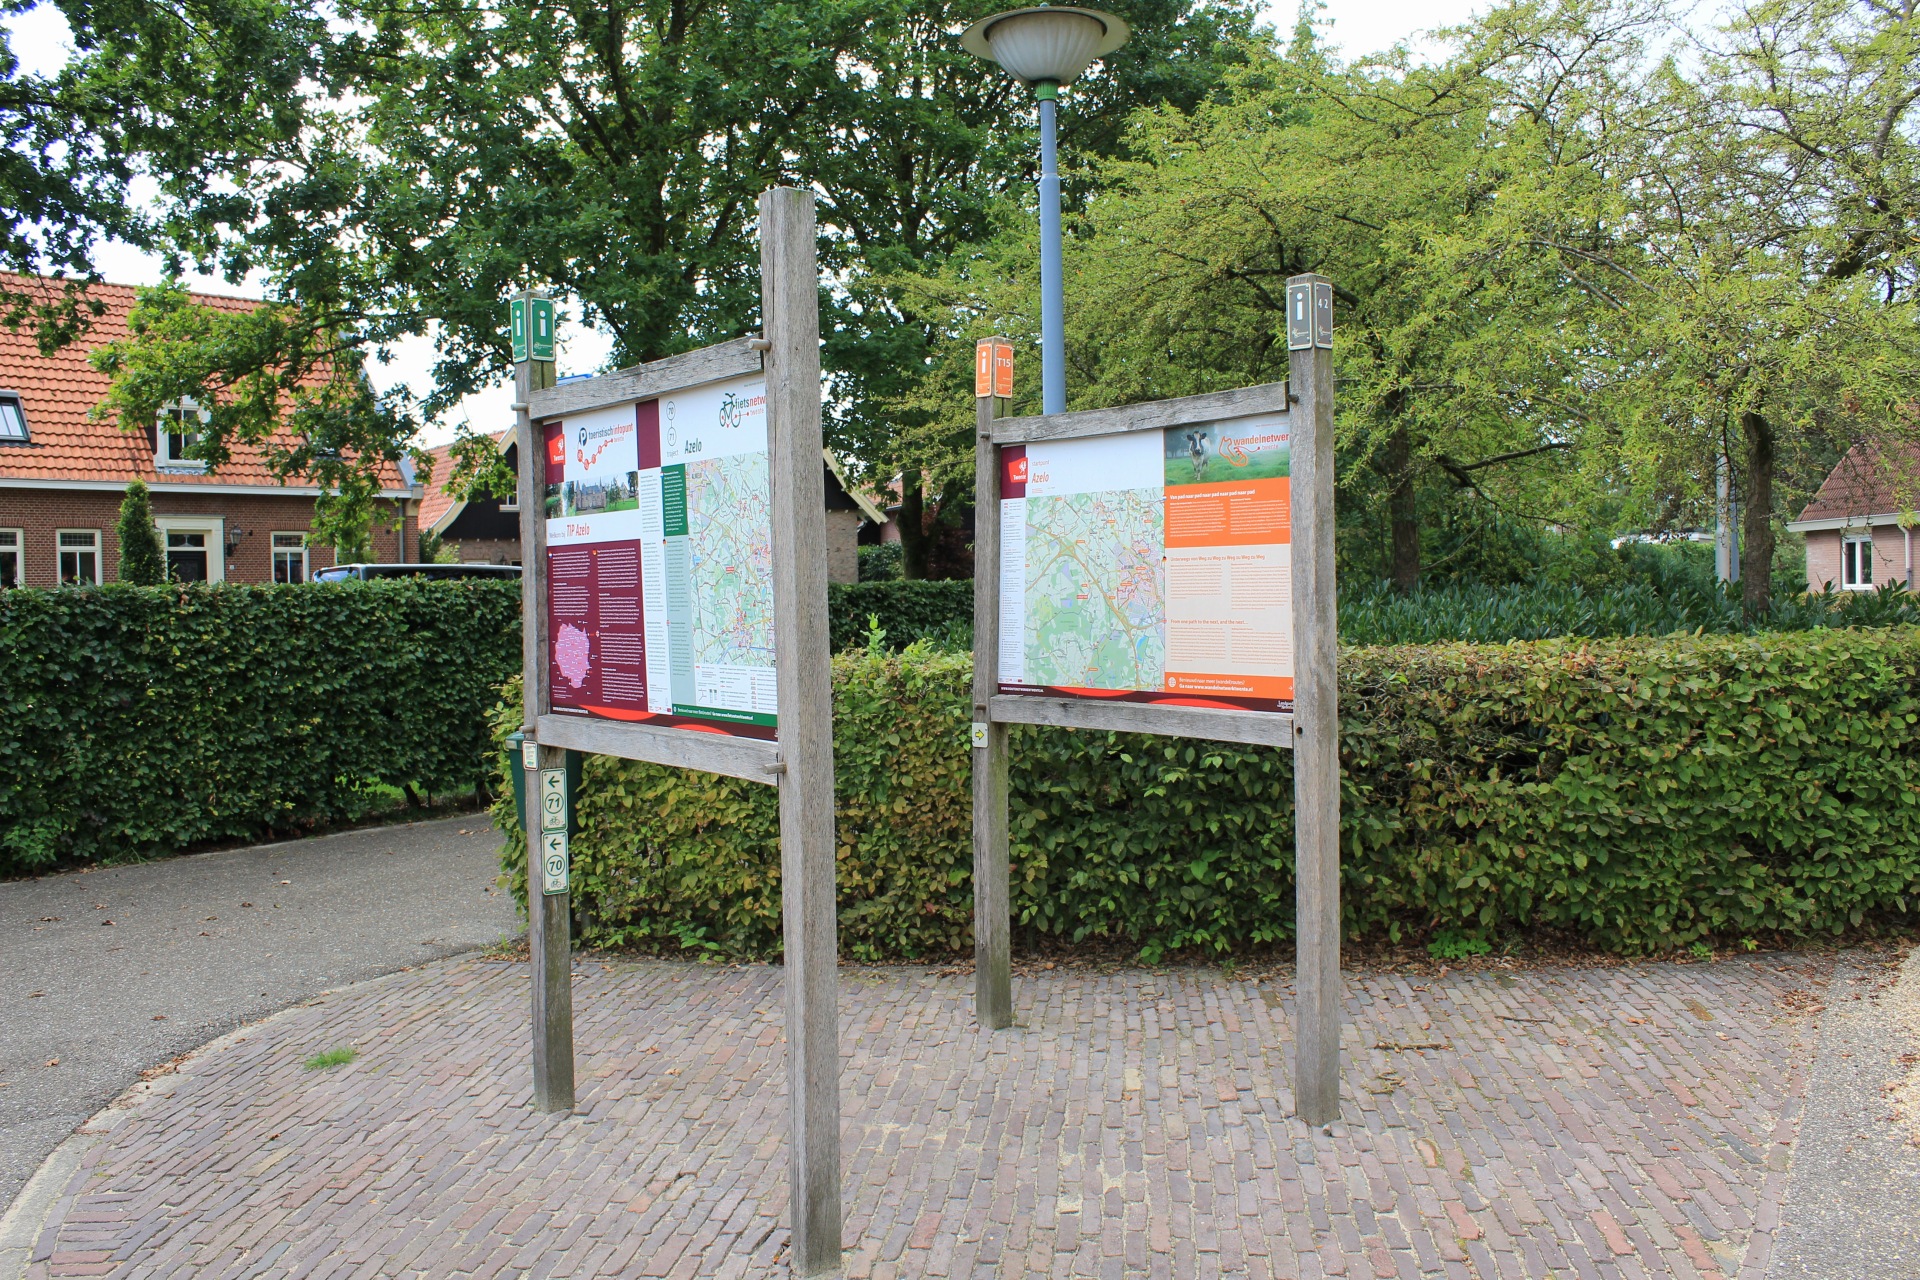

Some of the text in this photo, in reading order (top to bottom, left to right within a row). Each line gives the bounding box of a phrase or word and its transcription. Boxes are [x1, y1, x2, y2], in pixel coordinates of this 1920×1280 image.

[996, 357, 1011, 368] T15
[735, 395, 768, 410] fietsnetw
[684, 438, 702, 454] Azelo
[1233, 433, 1290, 447] wandelnetwer
[1031, 471, 1050, 484] Azelo
[1178, 493, 1186, 501] pad
[566, 524, 575, 537] TIP
[575, 521, 591, 537] Azelo
[548, 797, 560, 810] 71
[549, 859, 562, 872] 70
